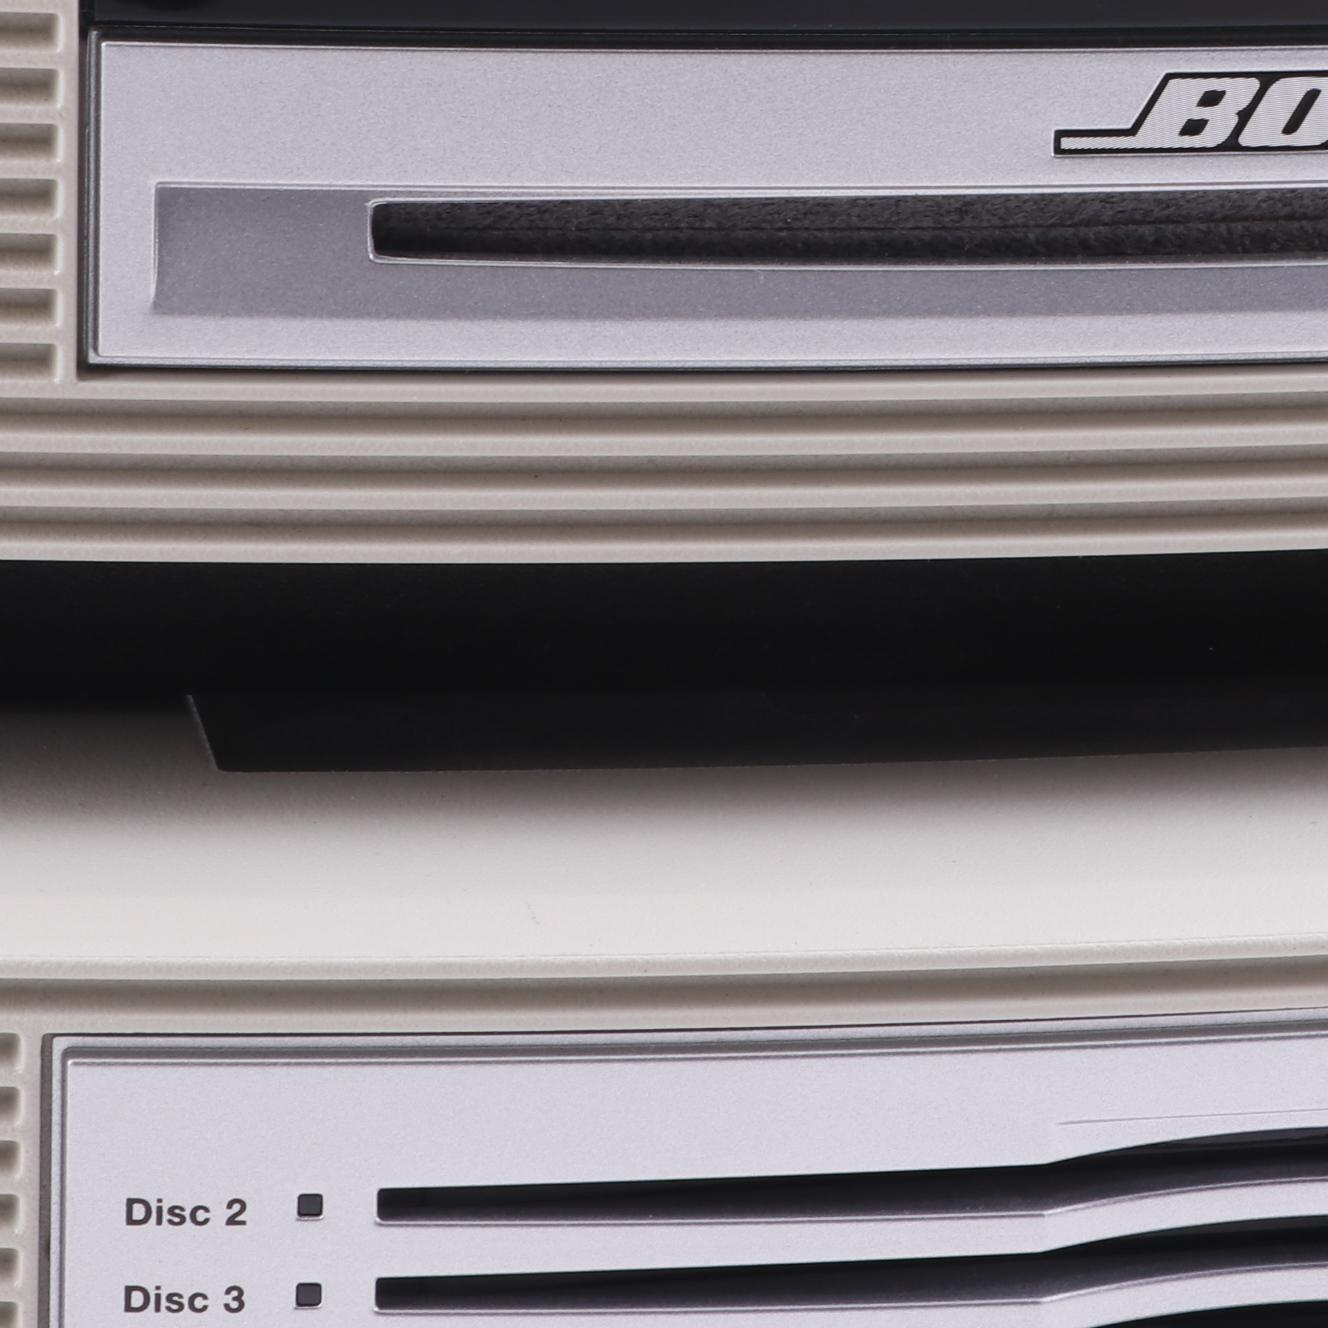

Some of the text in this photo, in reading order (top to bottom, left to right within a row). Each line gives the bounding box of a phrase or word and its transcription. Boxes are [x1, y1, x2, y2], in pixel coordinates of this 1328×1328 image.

[125, 1197, 247, 1226] Disc 2
[124, 1285, 245, 1313] Disc 3
